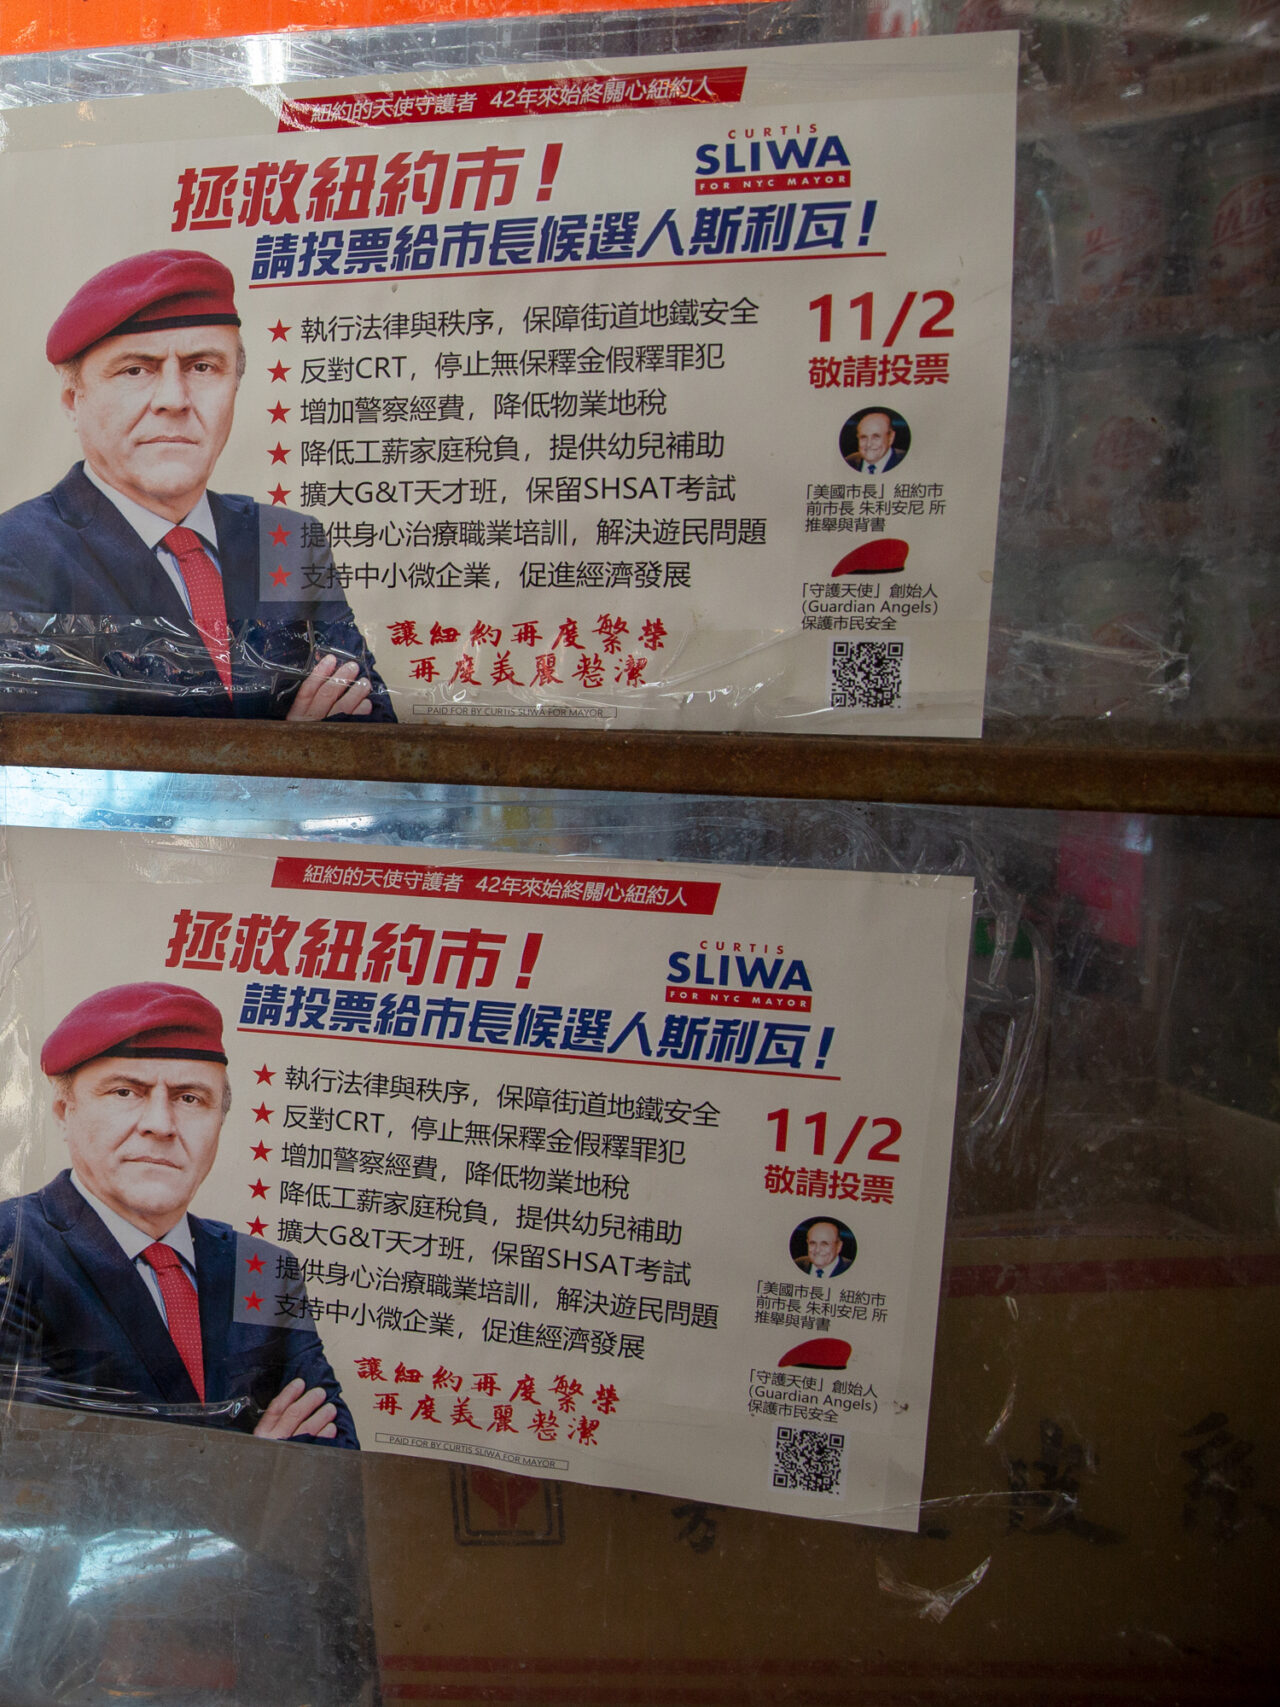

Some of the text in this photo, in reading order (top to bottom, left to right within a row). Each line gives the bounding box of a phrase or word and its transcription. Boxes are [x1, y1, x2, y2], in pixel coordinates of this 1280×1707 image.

[310, 77, 714, 123] 紐約的天使守護者 42年來始終關心紐約人
[727, 123, 818, 140] CURTIS
[695, 135, 852, 176] SLIWA
[699, 174, 846, 192] FOR NYC MAYOR
[809, 289, 955, 348] 11/2
[808, 352, 950, 389] 敬請投票
[806, 498, 947, 517] 前市長 朱利安尼 所
[805, 517, 886, 533] 推舉與背書
[801, 599, 939, 617] (Guardian Angels)
[801, 615, 898, 632] 保護市民安全
[427, 706, 449, 715] PAID
[449, 707, 468, 716] FOR
[471, 707, 483, 716] BY
[547, 708, 567, 717] FOR
[569, 708, 604, 718] MAYOR
[302, 863, 688, 909] 紐約的天使守護者 42年來始終關心紐約人
[699, 940, 784, 955] CURTIS
[666, 951, 813, 992] SLIWA
[669, 991, 807, 1008] FOR NYC MAYOR
[767, 1108, 903, 1165] 11/2
[763, 1164, 895, 1205] 敬請投票
[754, 1310, 832, 1332] 推舉與背書
[806, 1302, 868, 1321] 朱利安尼
[871, 1307, 889, 1324] 所
[748, 1384, 879, 1415] (Guardian Angels)
[748, 1399, 839, 1424] 保護市民安全
[389, 1435, 556, 1469] PAID FOR BY CURTIS SLIWA FOR MAYOR
